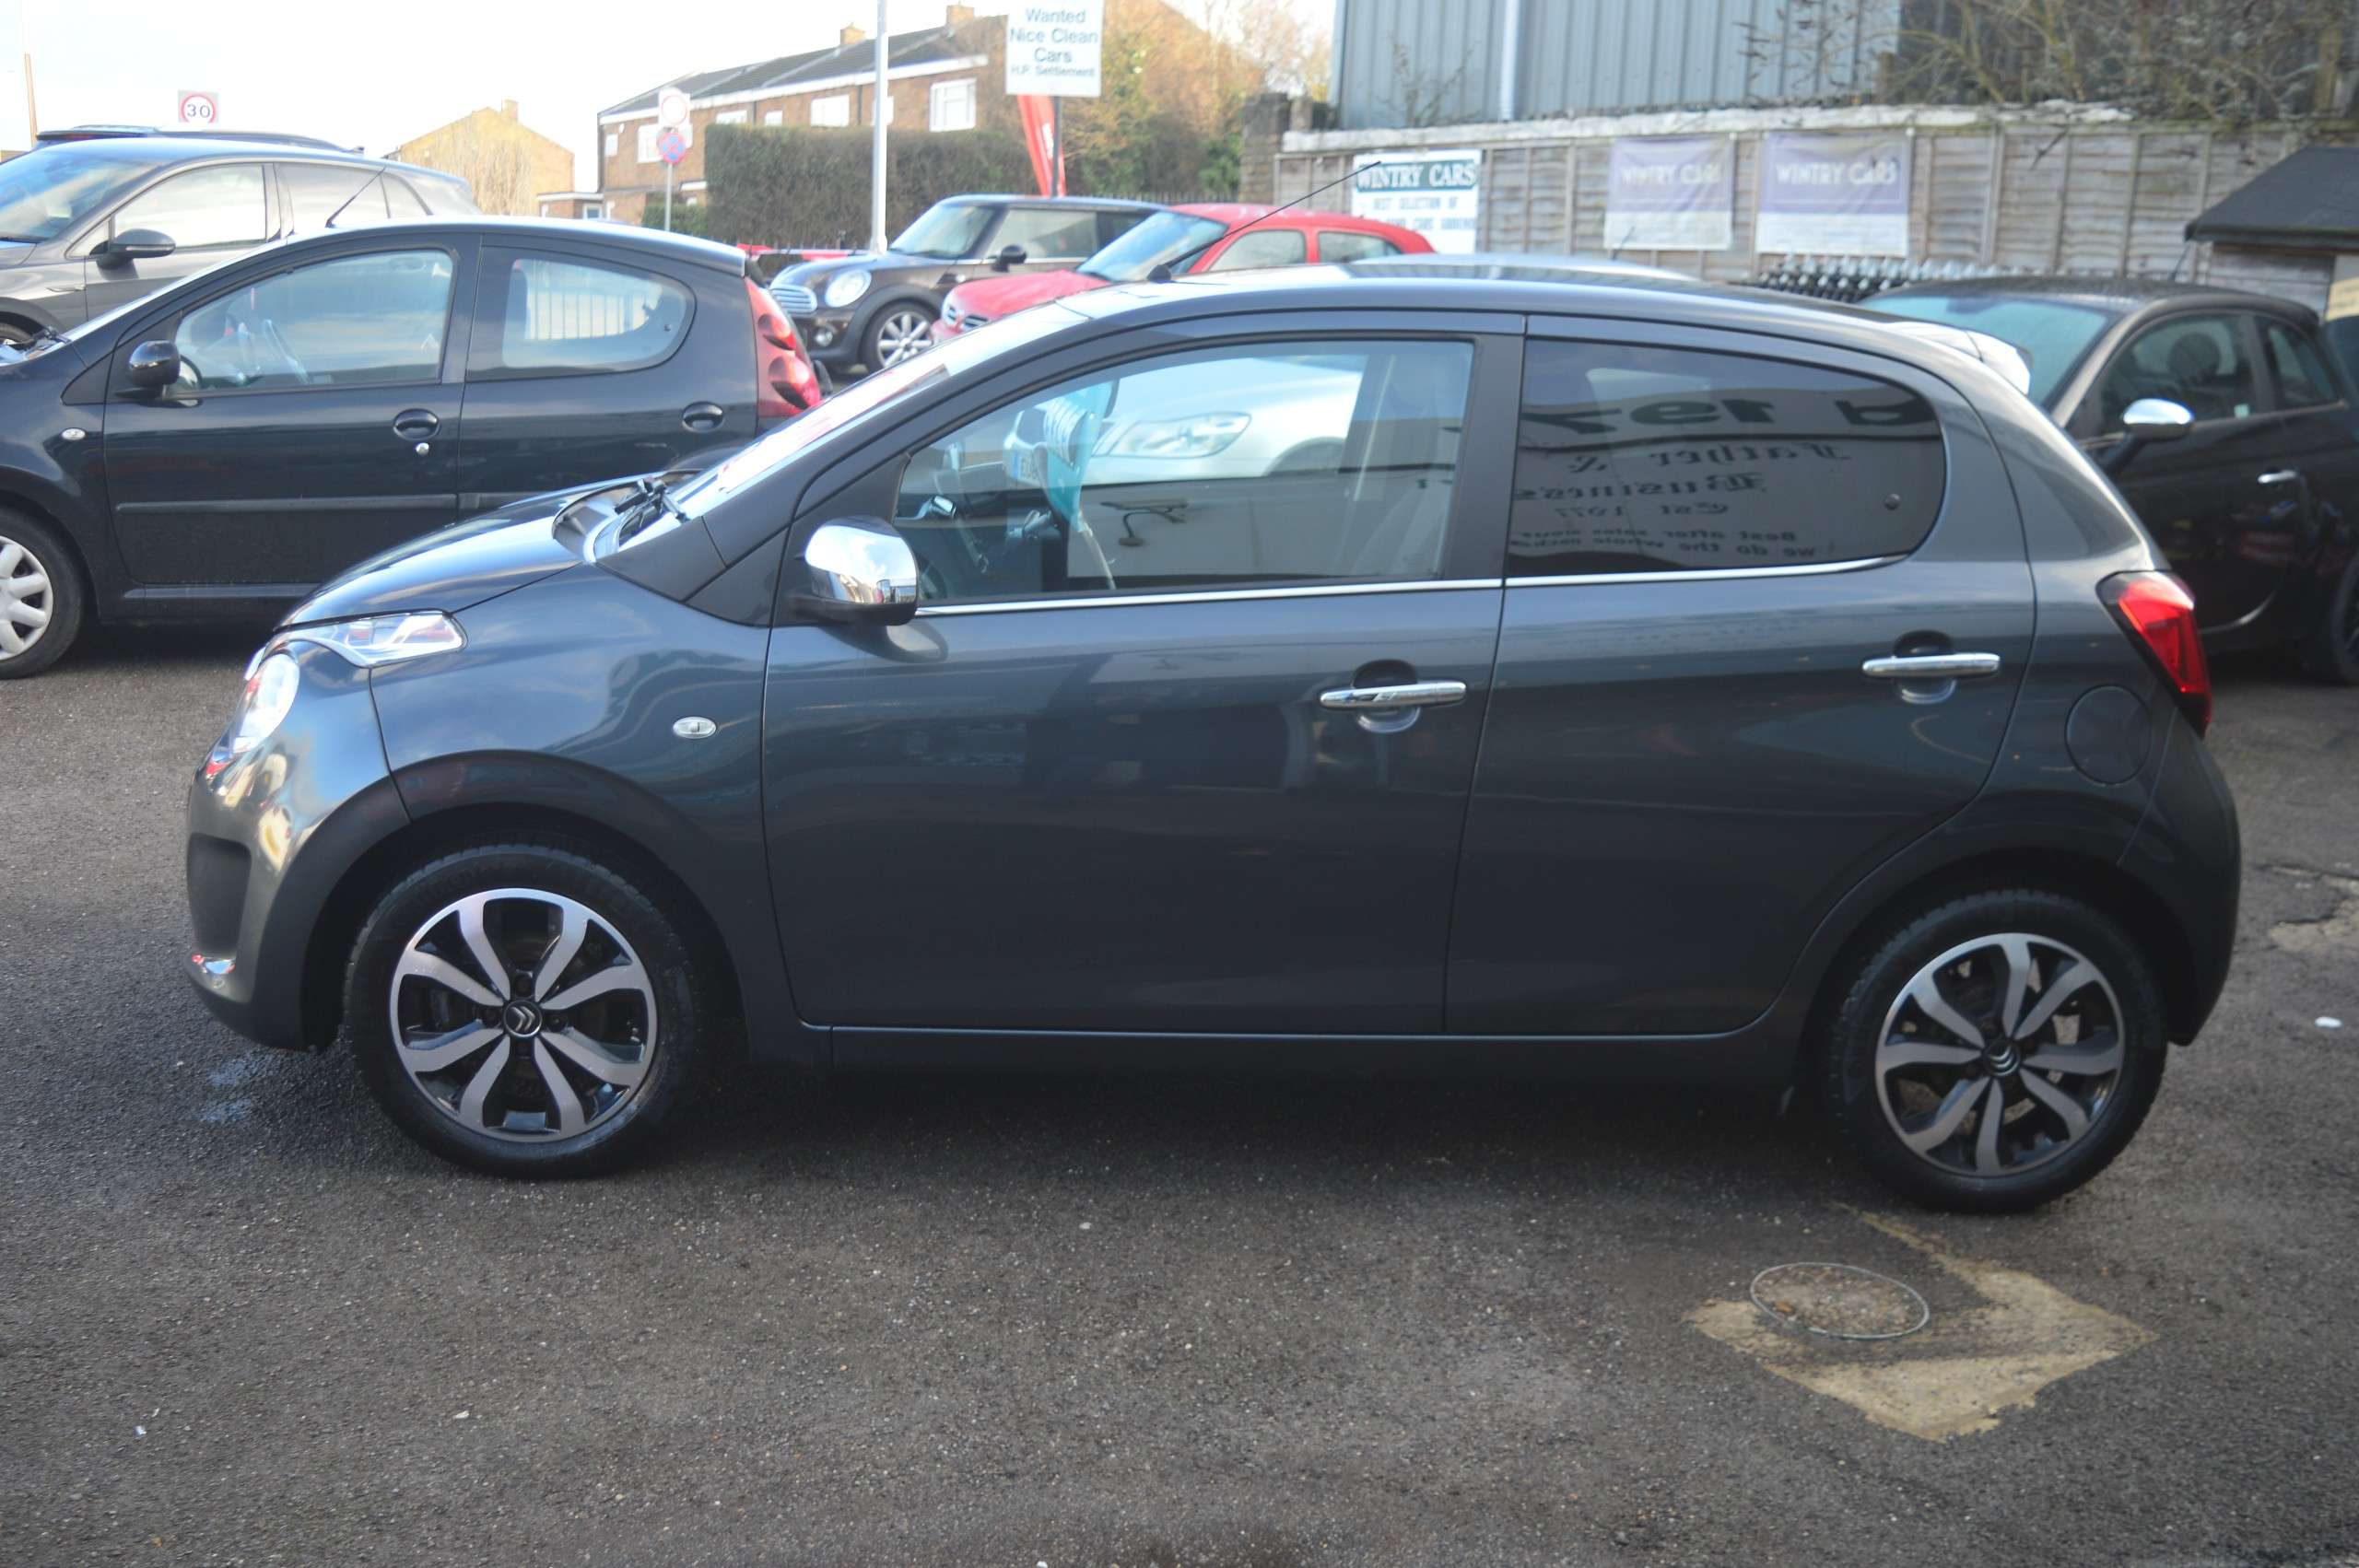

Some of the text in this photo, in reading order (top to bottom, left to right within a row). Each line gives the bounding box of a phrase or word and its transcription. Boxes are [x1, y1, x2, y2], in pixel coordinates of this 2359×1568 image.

[1026, 8, 1086, 23] Wanted
[1010, 28, 1098, 43] Nice Clean
[1034, 47, 1073, 63] Cars
[187, 103, 210, 118] 30
[1357, 162, 1476, 189] WINTRY CARS
[1776, 161, 1898, 184] WINTRY CARS
